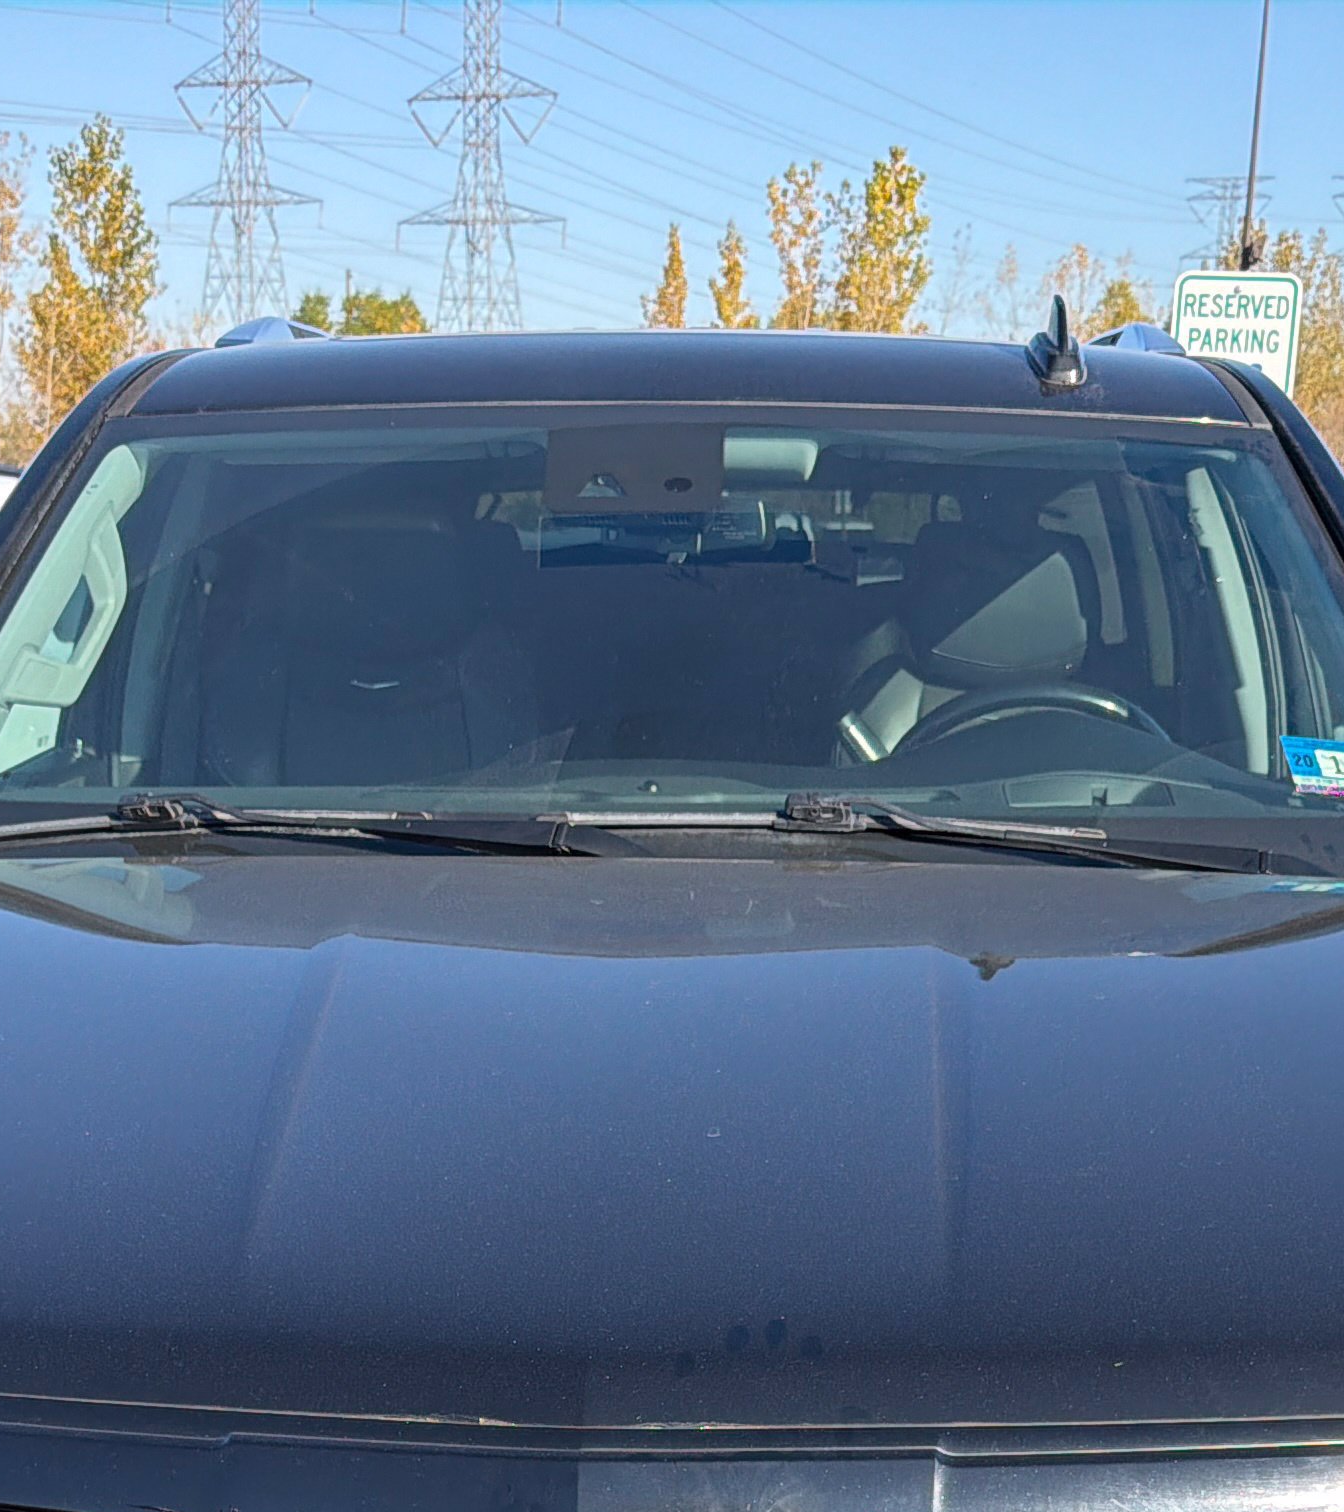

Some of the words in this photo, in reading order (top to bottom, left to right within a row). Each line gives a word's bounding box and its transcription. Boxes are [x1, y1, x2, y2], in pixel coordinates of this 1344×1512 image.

[1183, 293, 1290, 320] RESERVED
[1187, 327, 1280, 354] PARKING
[1291, 753, 1314, 769] 20
[1328, 755, 1344, 776] 1
